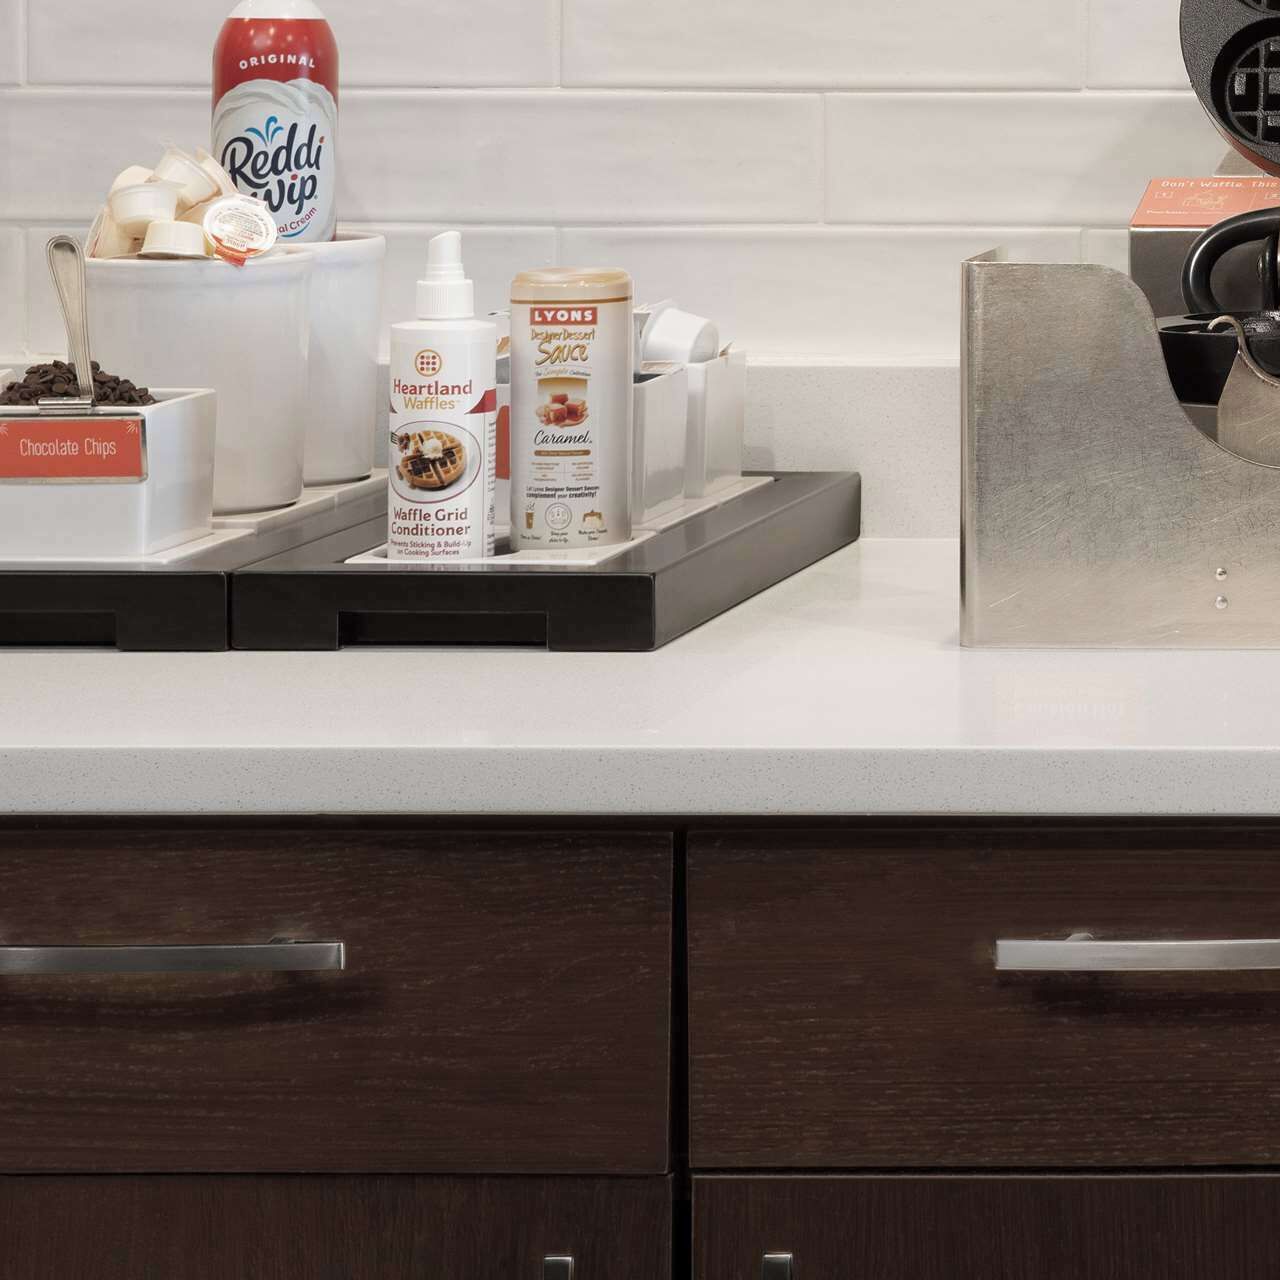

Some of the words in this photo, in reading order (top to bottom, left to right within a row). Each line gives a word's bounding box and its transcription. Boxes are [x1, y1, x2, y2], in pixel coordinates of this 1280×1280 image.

[239, 53, 316, 71] ORIGINAL
[221, 122, 326, 189] Reddi
[289, 206, 318, 230] Cream
[534, 309, 593, 321] LYONS
[562, 327, 595, 340] Dessert
[535, 342, 589, 366] Sauce
[393, 378, 472, 396] Heartland
[403, 396, 456, 410] Waffles
[534, 429, 590, 446] Caramel
[19, 438, 79, 456] Chocolate
[84, 437, 117, 459] Chips
[394, 507, 431, 521] Waffle
[434, 507, 468, 521] Grid
[391, 523, 471, 536] Conditioner
